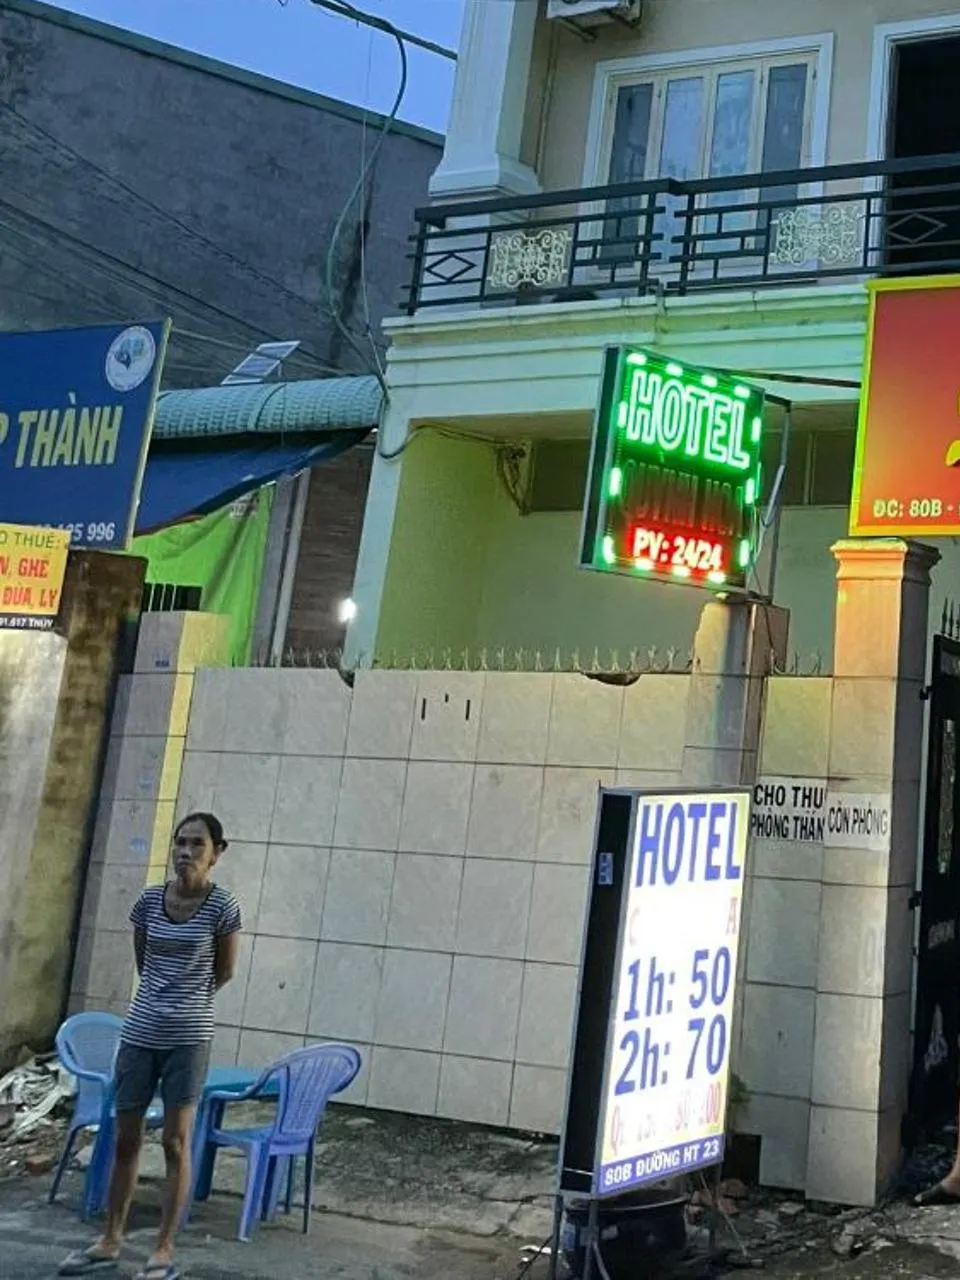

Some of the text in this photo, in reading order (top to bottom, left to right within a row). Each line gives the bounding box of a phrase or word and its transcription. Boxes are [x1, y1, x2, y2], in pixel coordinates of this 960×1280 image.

[15, 391, 124, 468] THÀNH
[626, 368, 750, 470] HOTEL
[86, 522, 115, 541] 996
[909, 498, 942, 517] 80B
[632, 526, 670, 563] PV:
[753, 784, 786, 806] CHO
[634, 801, 741, 888] HOTEL
[622, 946, 732, 1022] 1h: 50
[614, 1014, 726, 1096] 2h: 70
[636, 1149, 681, 1177] ĐƯỜNG
[683, 1143, 700, 1164] HT
[702, 1139, 720, 1159] 23
